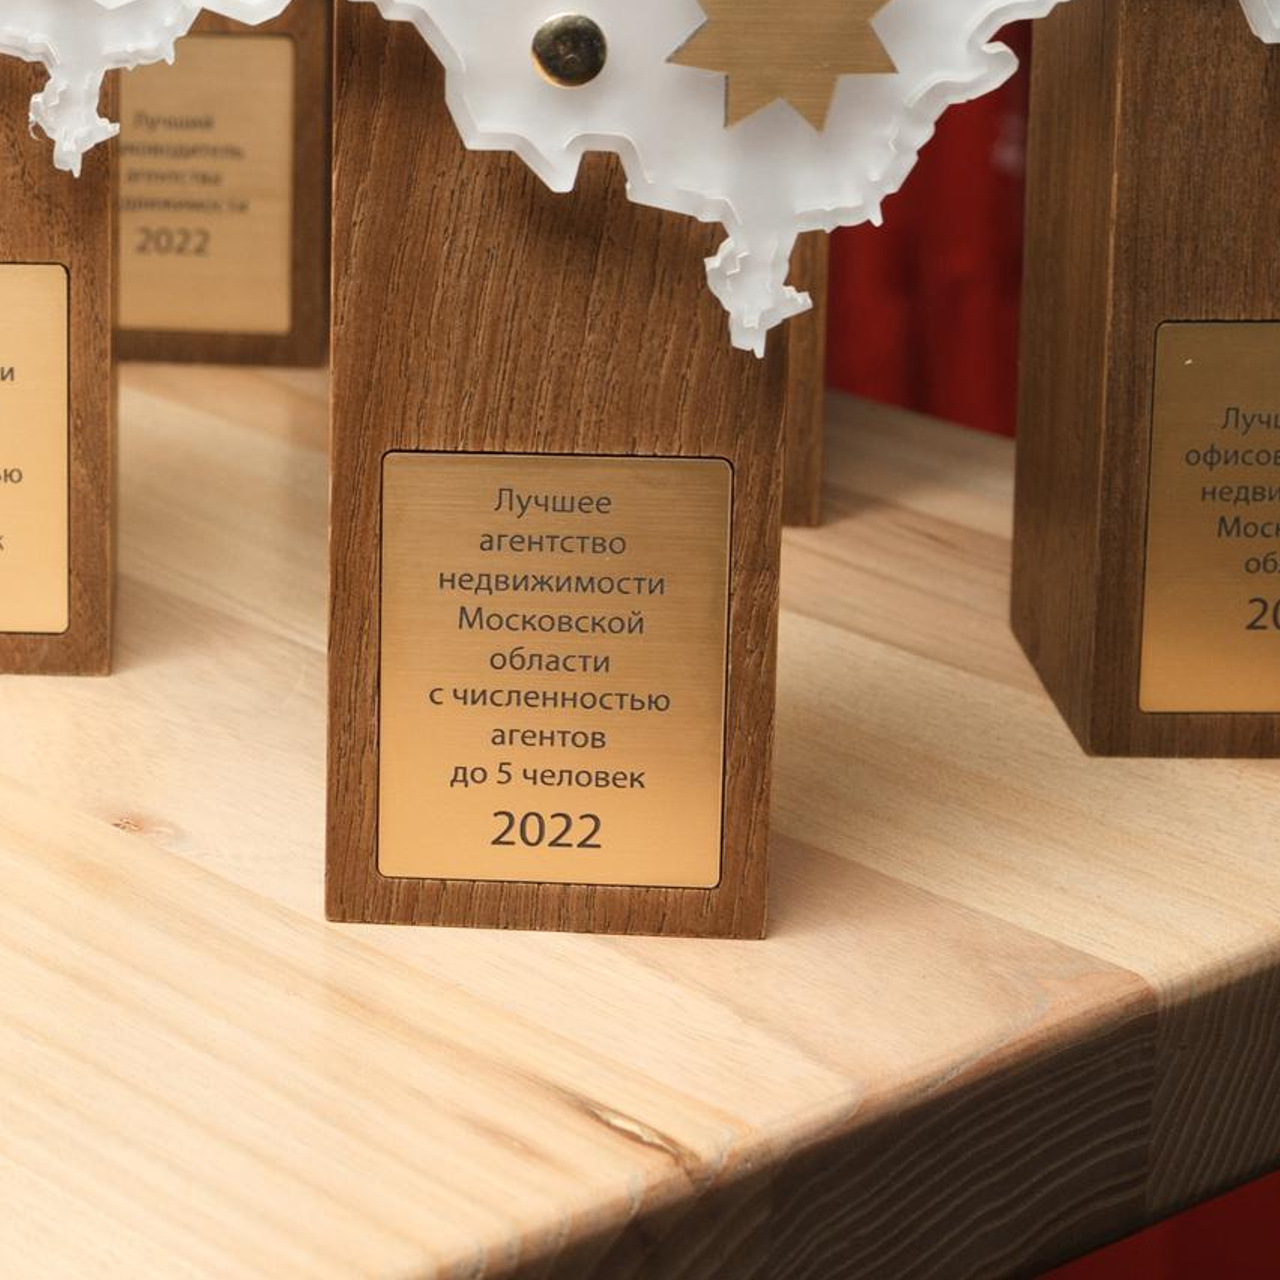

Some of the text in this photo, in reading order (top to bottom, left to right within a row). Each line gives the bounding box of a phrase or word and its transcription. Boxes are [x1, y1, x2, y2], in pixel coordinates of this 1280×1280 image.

[135, 226, 210, 255] 2022
[1221, 407, 1280, 436] Луч
[494, 487, 612, 518] Лучшее
[479, 532, 626, 555] агентство
[1245, 551, 1280, 573] об
[439, 570, 665, 596] недвижимости
[458, 605, 644, 634] Московской
[490, 645, 609, 673] области
[429, 686, 670, 712] с численностью
[491, 727, 606, 749] агентов
[450, 762, 645, 789] до 5 человек
[490, 810, 602, 849] 2022
